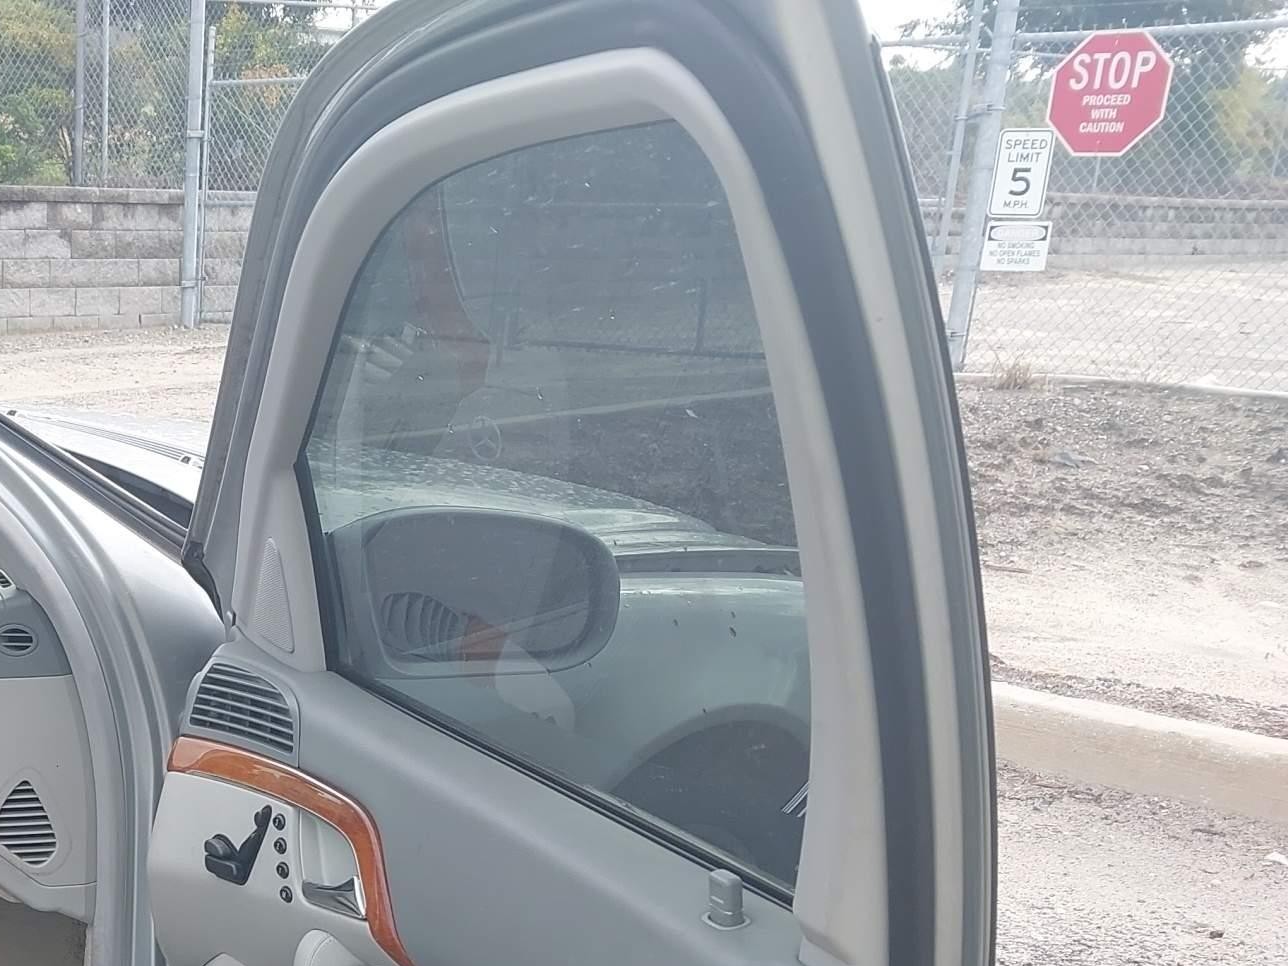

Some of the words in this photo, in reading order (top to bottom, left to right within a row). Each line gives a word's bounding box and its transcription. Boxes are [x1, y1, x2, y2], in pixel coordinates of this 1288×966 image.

[1069, 50, 1157, 90] STOP
[1081, 94, 1131, 106] PROCEED
[1091, 108, 1118, 119] WITH
[1079, 121, 1125, 133] CAUTION
[1005, 138, 1048, 150] SPEED
[1007, 152, 1042, 163] LIMIT
[1008, 167, 1032, 196] 5
